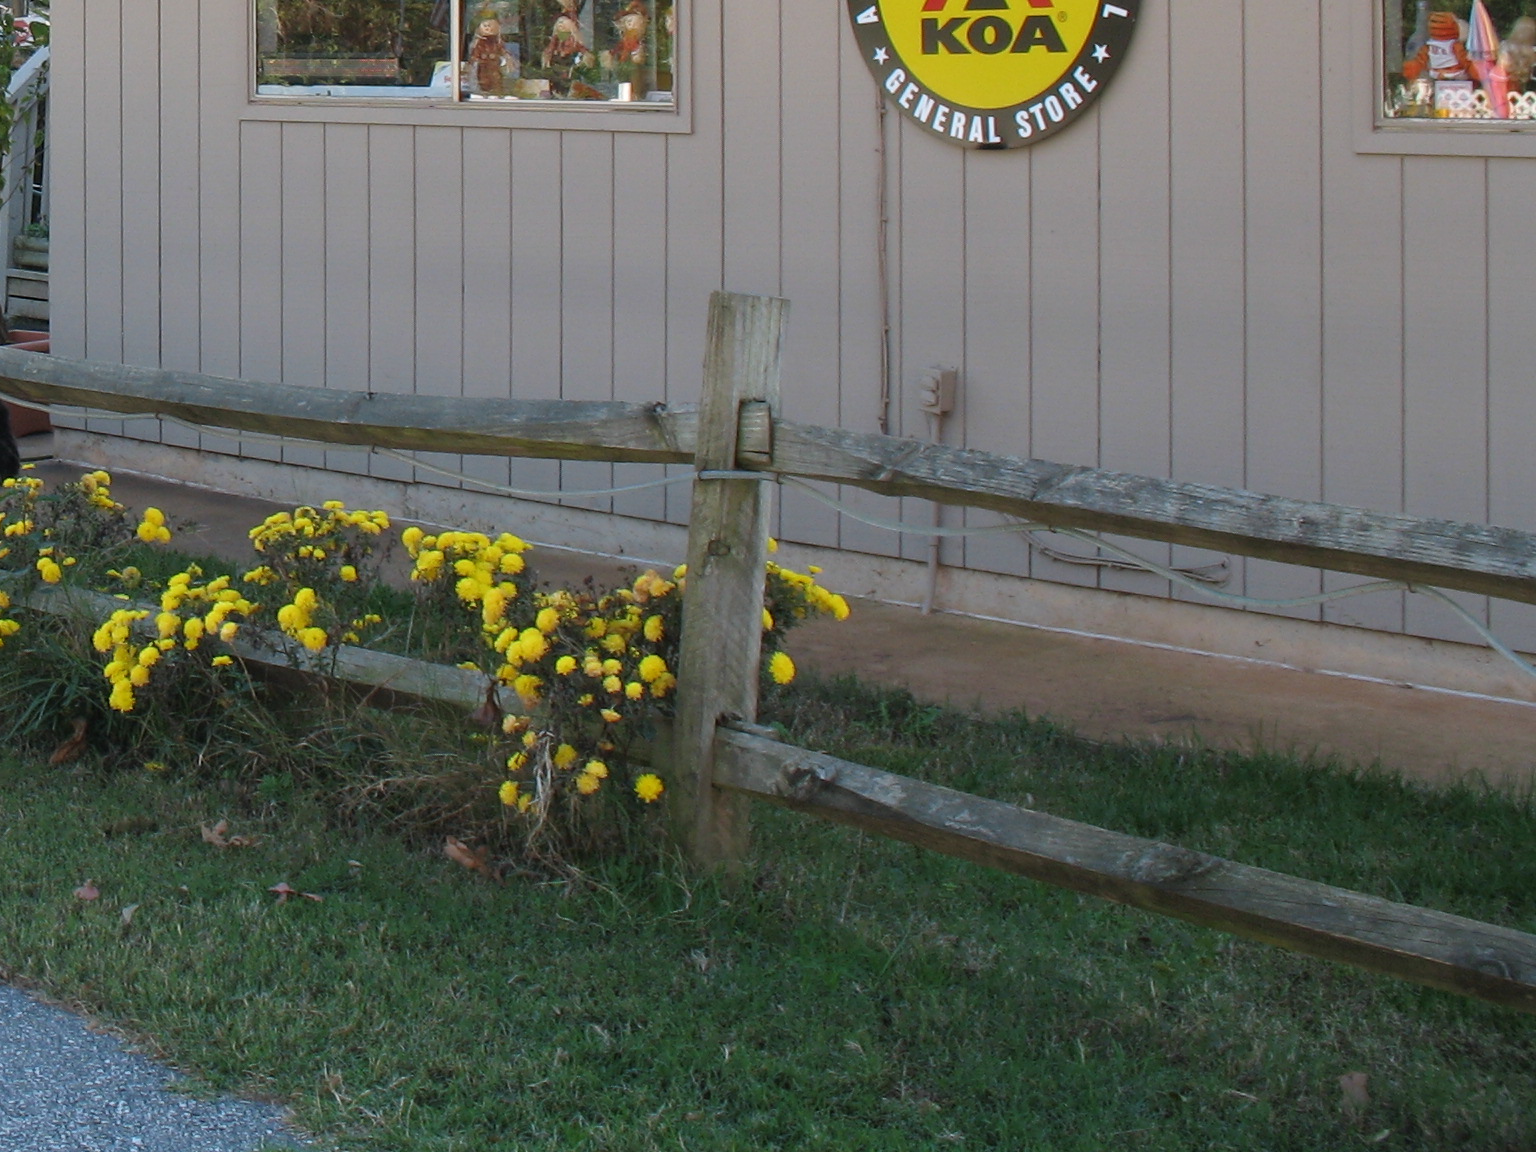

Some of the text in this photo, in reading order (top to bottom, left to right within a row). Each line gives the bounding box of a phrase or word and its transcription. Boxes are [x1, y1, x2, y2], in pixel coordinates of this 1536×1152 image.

[920, 14, 1068, 55] KOA
[884, 65, 1098, 144] GENERAL STORE
